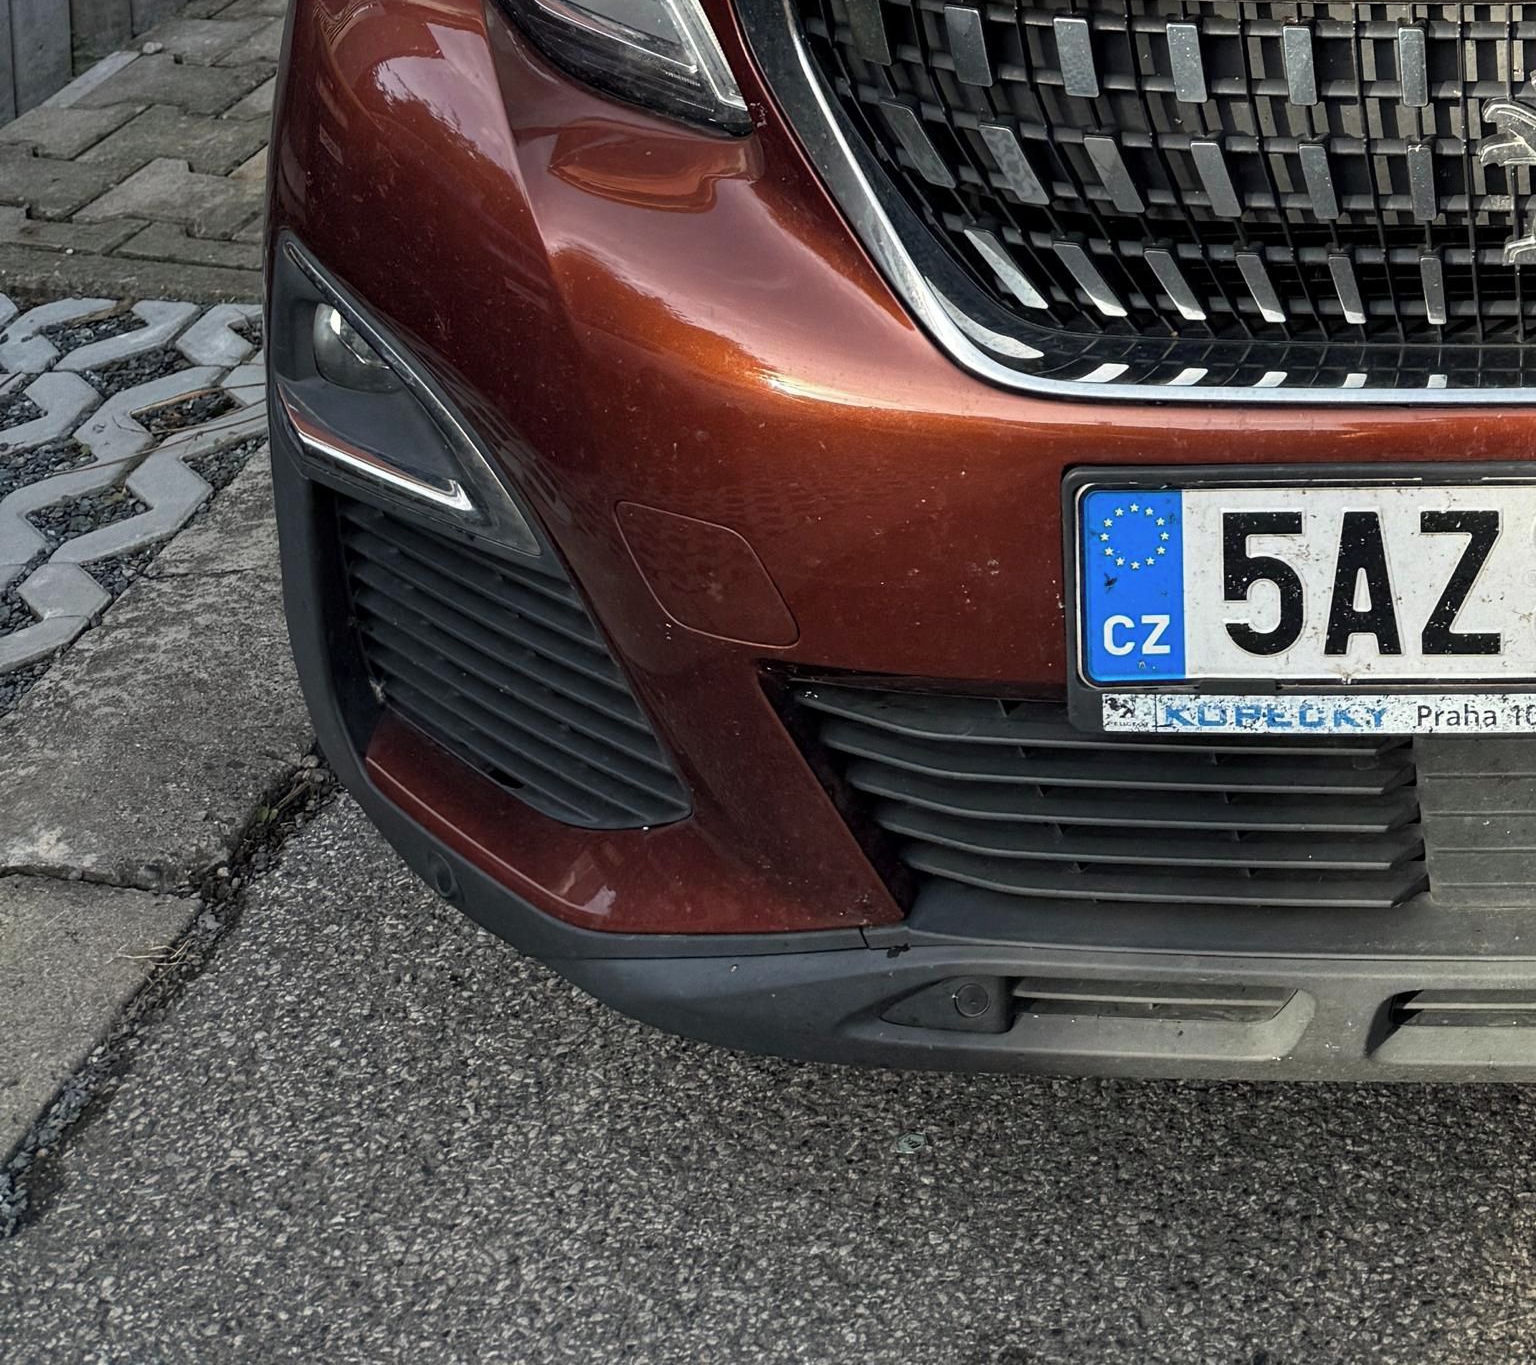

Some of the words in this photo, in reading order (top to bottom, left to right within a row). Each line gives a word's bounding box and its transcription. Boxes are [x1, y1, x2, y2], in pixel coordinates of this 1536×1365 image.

[1221, 509, 1503, 657] 5AZ
[1102, 614, 1171, 656] CZ
[1416, 703, 1498, 727] Praha
